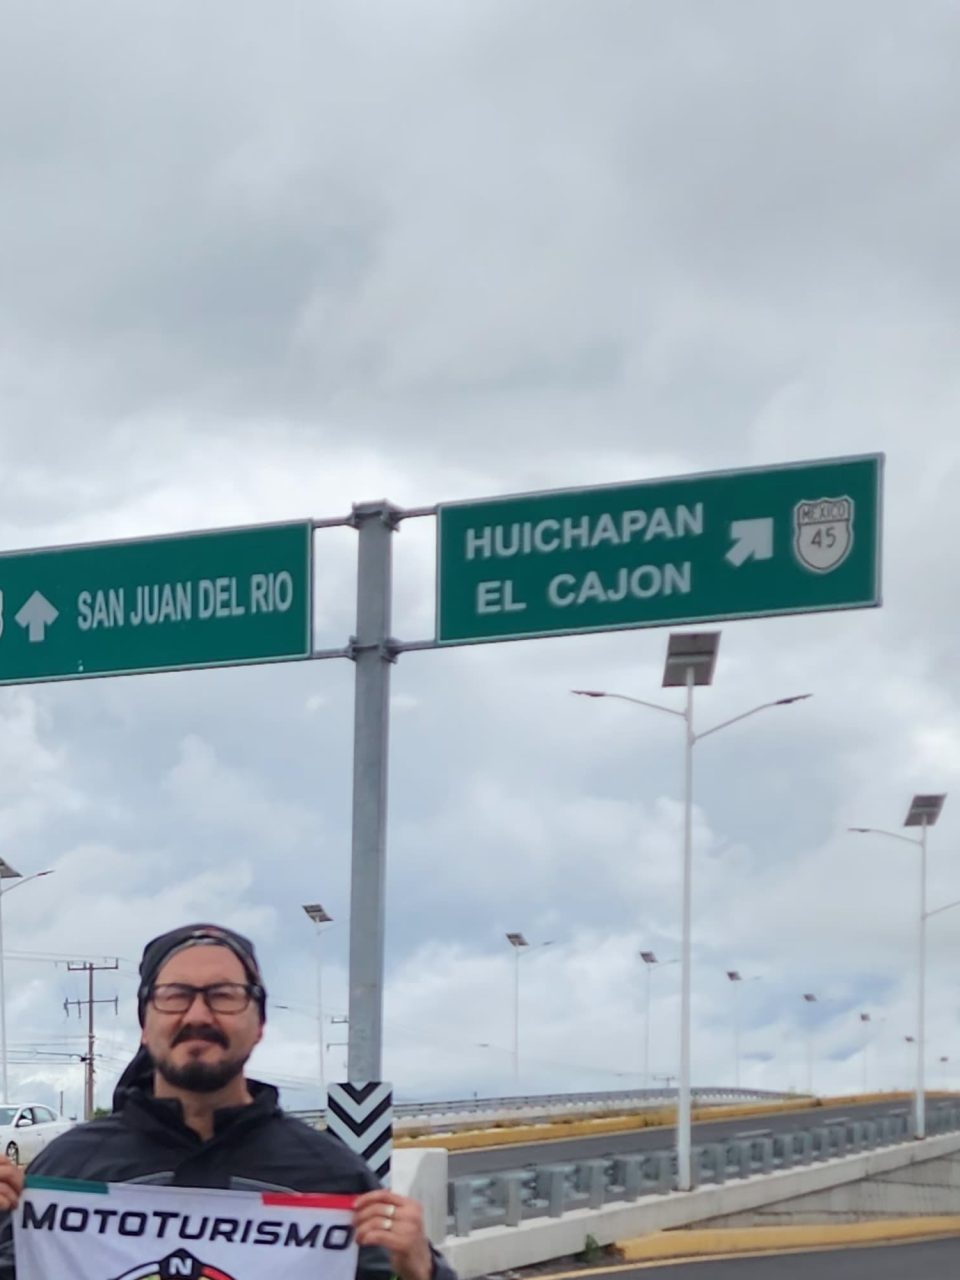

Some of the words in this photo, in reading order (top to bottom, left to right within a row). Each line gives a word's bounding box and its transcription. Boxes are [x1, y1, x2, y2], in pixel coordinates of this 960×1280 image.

[465, 502, 704, 560] HUICHAPAN
[810, 527, 837, 549] 45
[78, 588, 124, 630] SAN
[130, 580, 192, 626] JUAN
[198, 576, 244, 620] DEL
[250, 571, 293, 614] RIO
[476, 580, 526, 614] EL
[548, 561, 692, 607] CAJON
[21, 1201, 355, 1251] MOTOTURISMO
[168, 1257, 193, 1276] N
